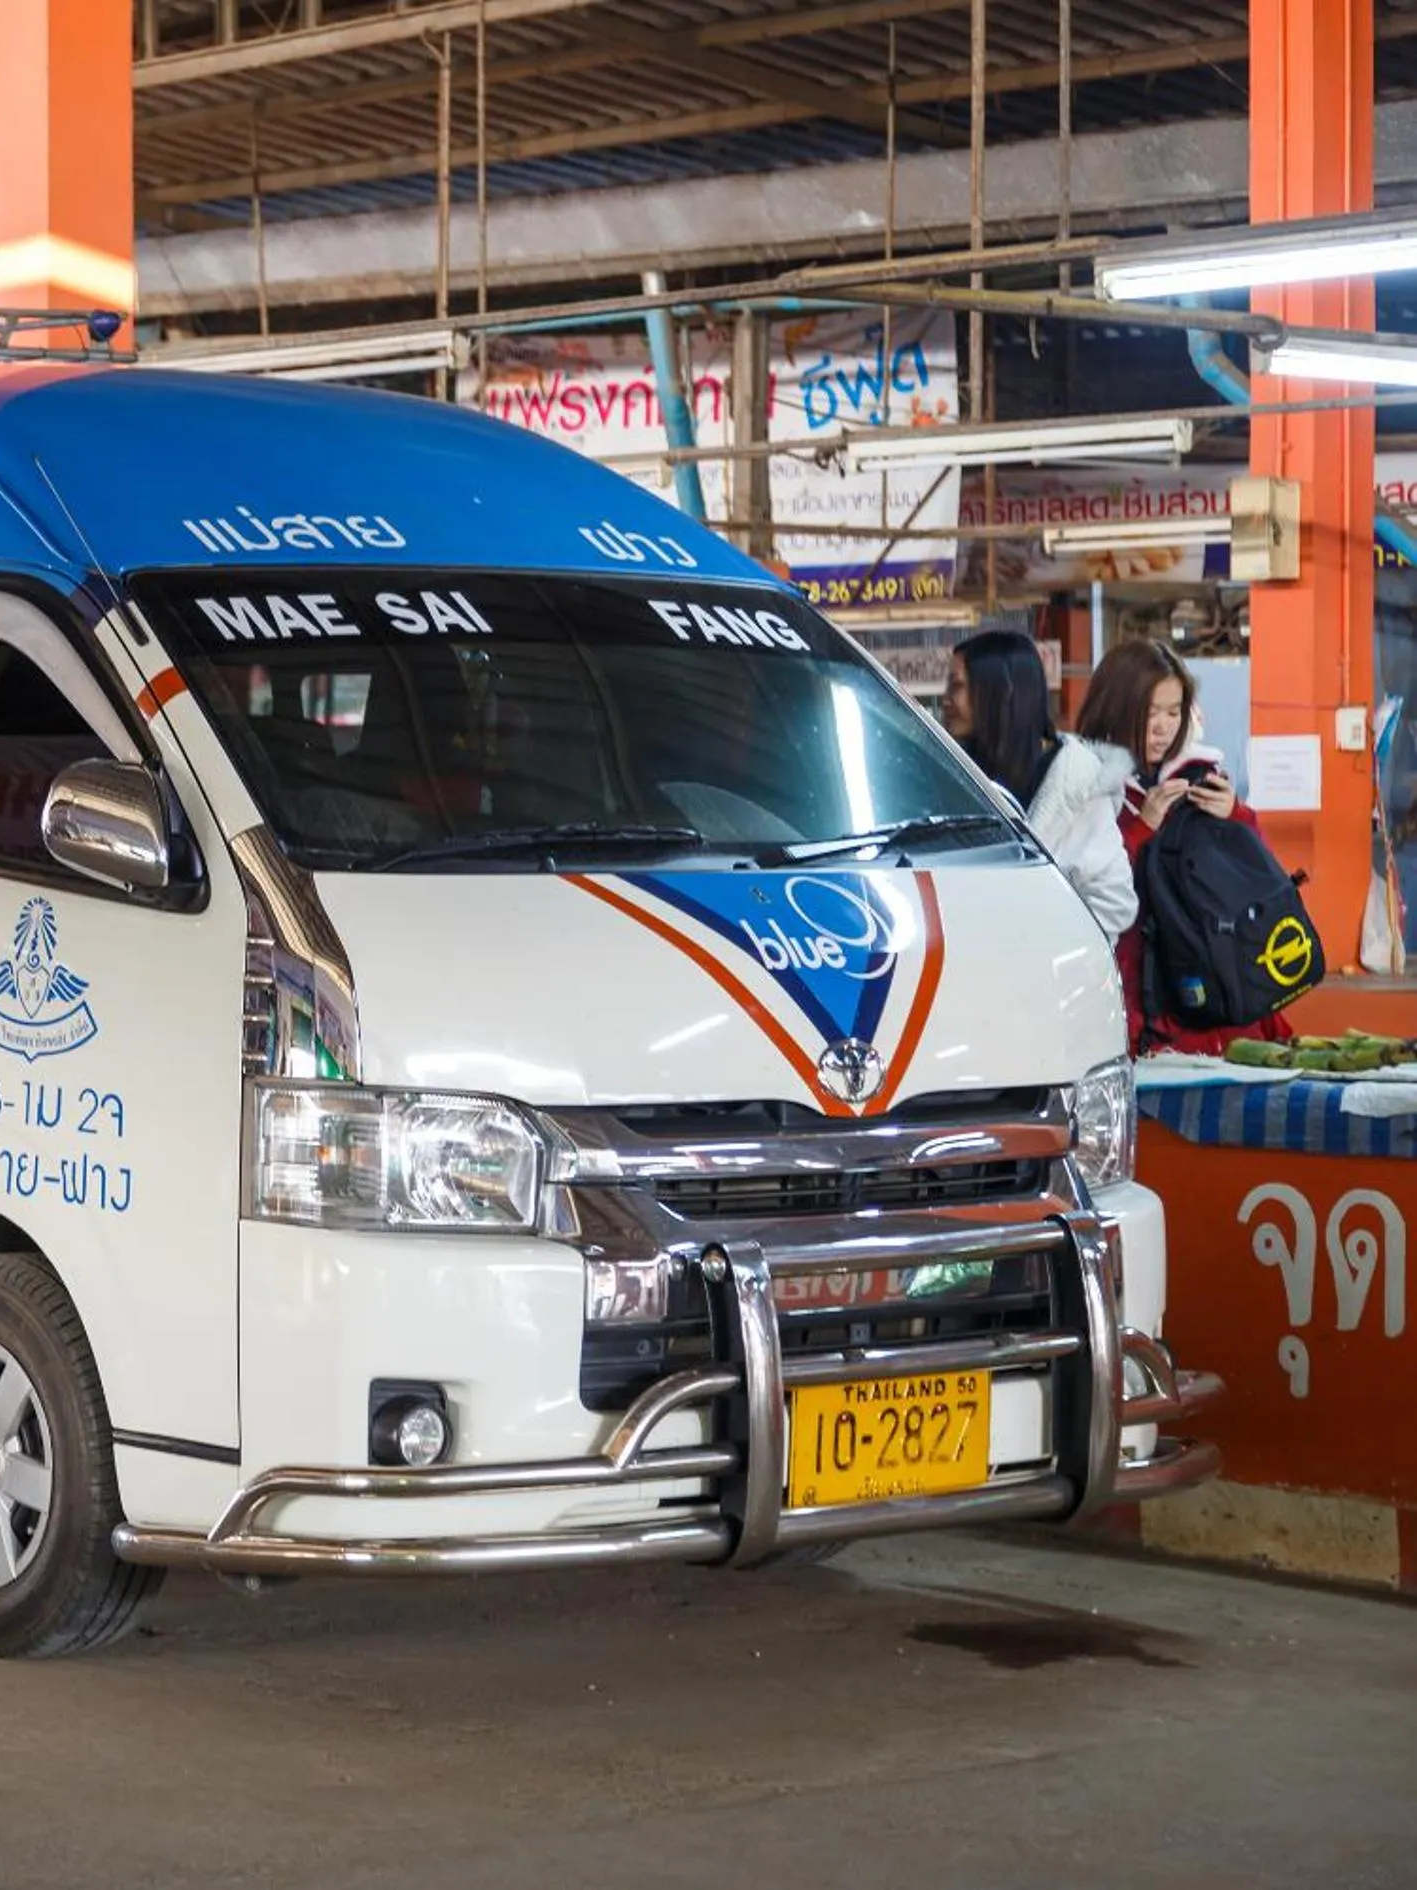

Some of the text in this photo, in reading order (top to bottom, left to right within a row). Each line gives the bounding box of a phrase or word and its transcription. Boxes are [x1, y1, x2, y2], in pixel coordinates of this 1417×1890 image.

[182, 506, 406, 554] แม่สาย
[578, 521, 698, 568] ฝาง
[195, 591, 493, 643] MAE SAI
[647, 600, 811, 652] FANG
[1237, 1182, 1406, 1398] จุด
[844, 1377, 947, 1404] THAILAND
[815, 1400, 979, 1475] 10-2827
